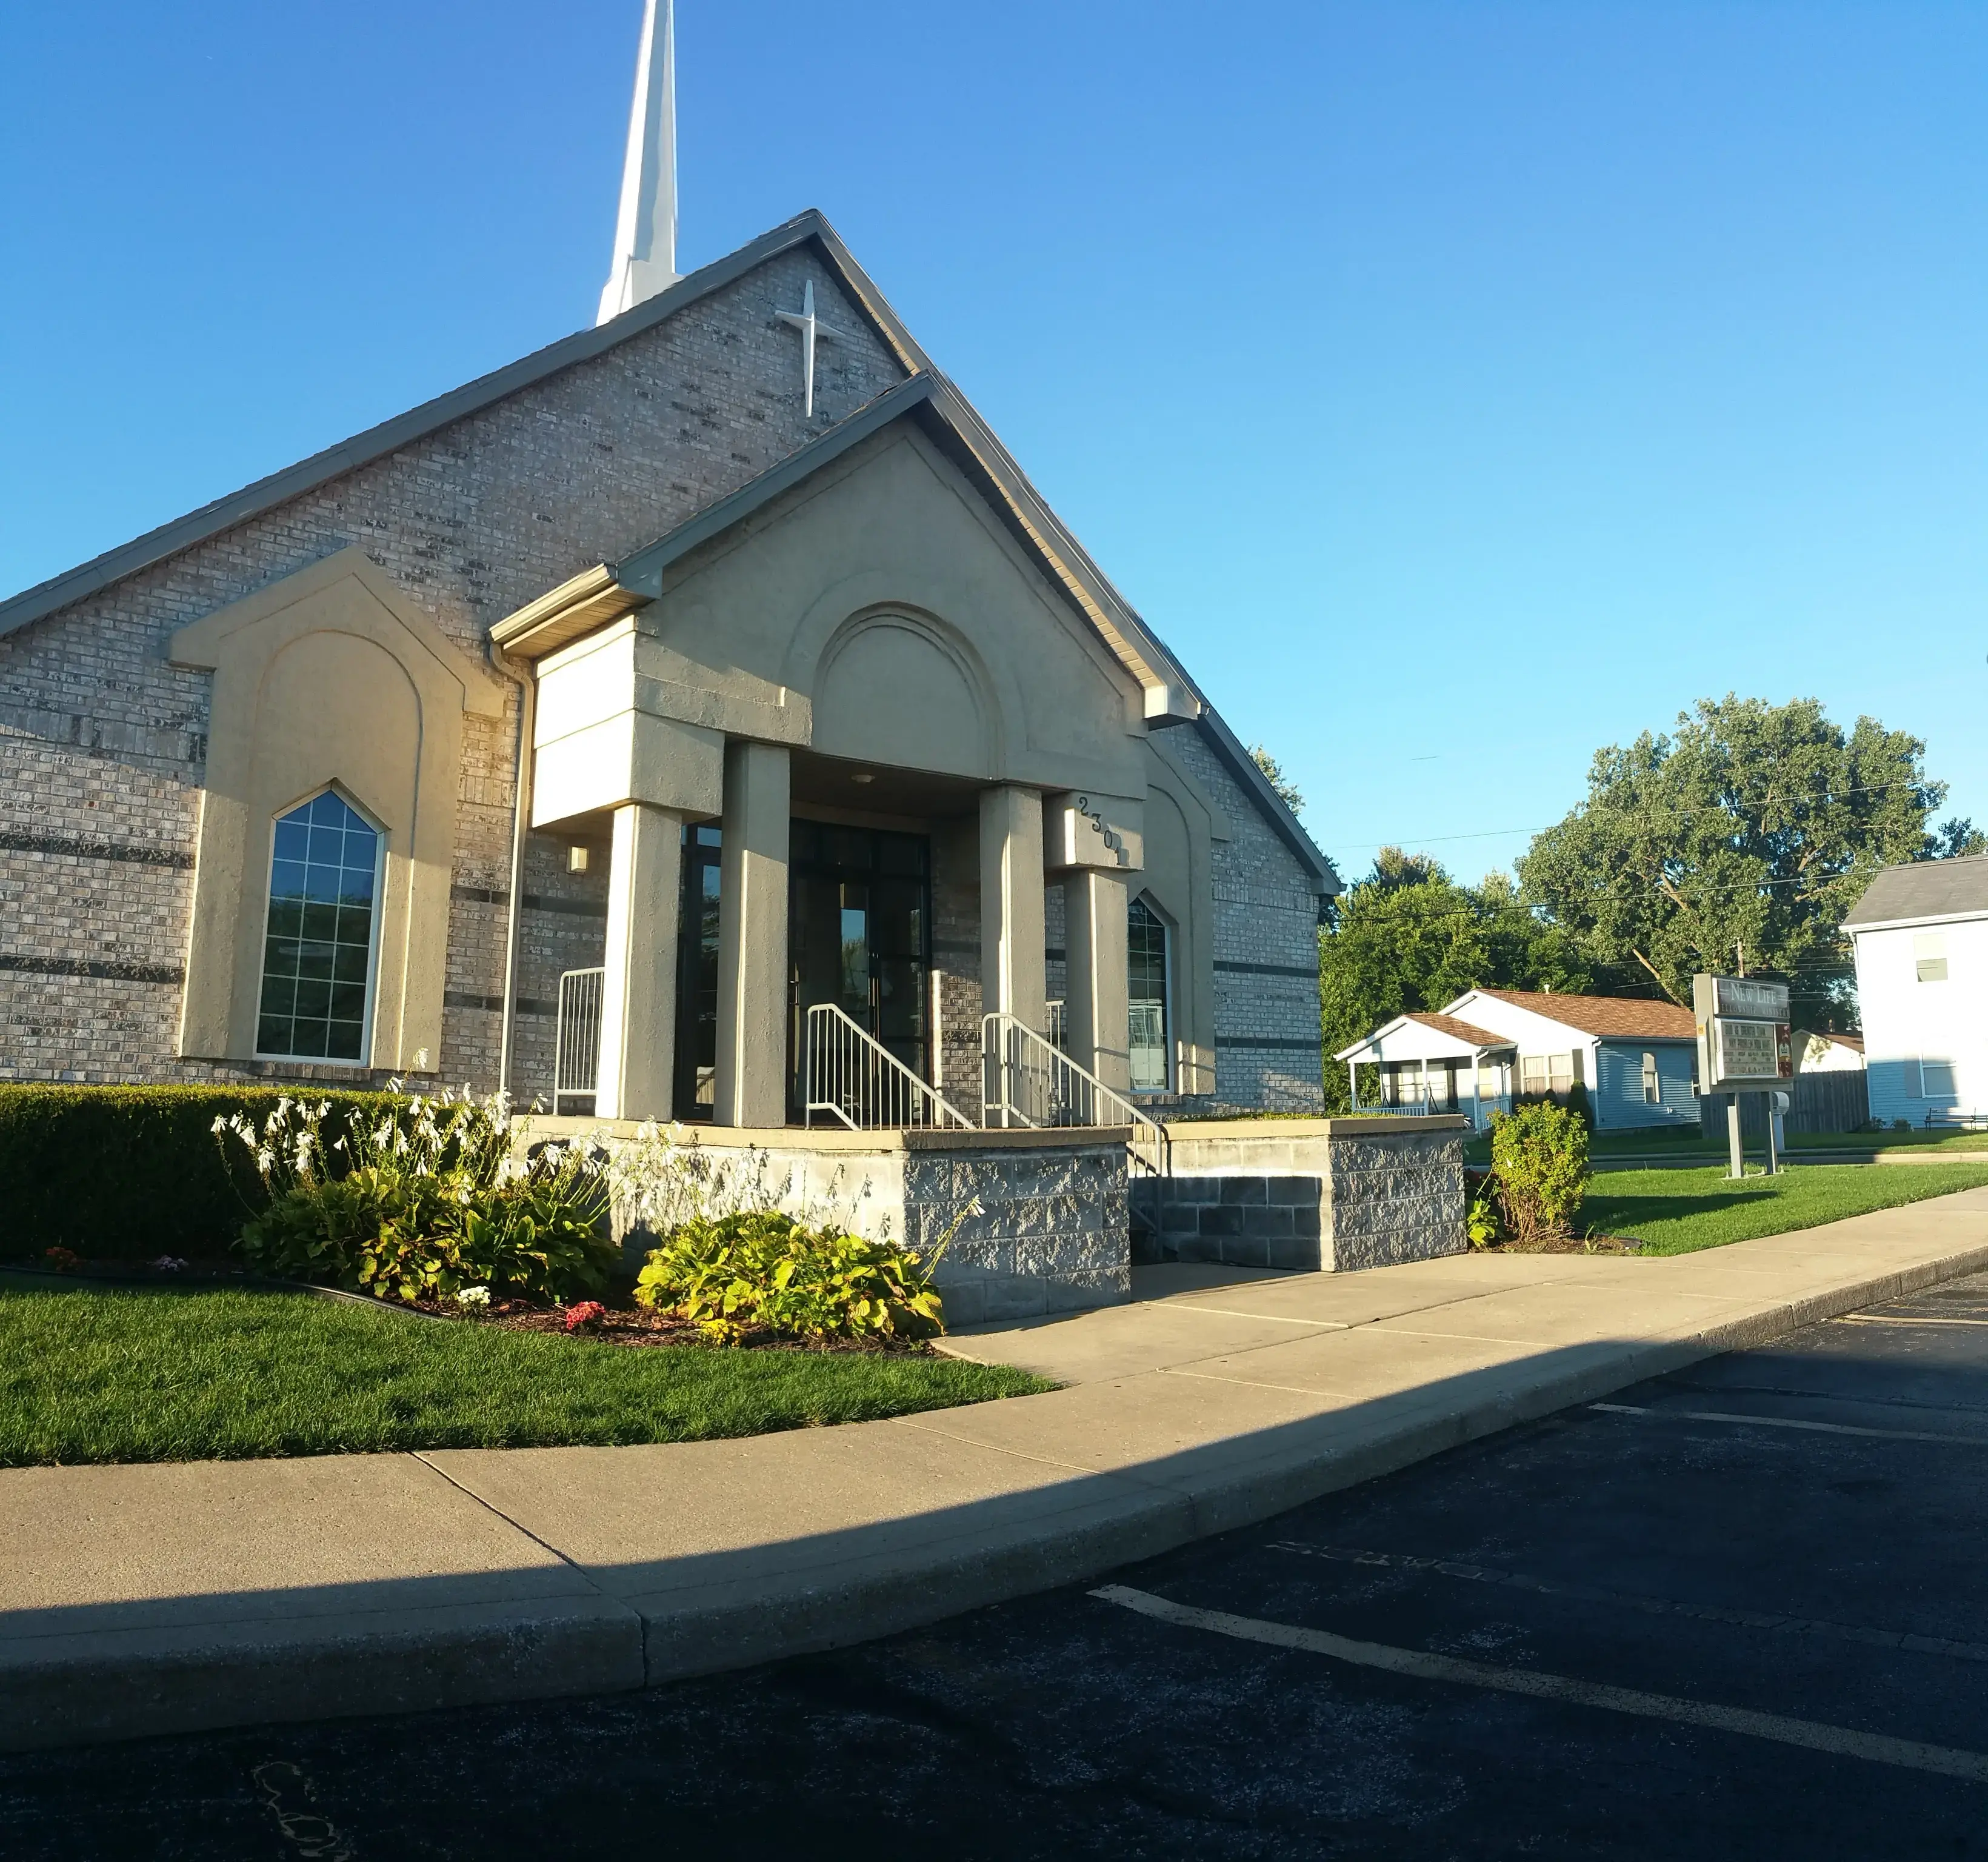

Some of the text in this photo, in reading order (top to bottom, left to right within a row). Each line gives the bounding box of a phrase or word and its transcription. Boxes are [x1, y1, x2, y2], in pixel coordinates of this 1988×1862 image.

[1079, 796, 1121, 866] 2301
[1730, 983, 1777, 1005] NEW LIFE
